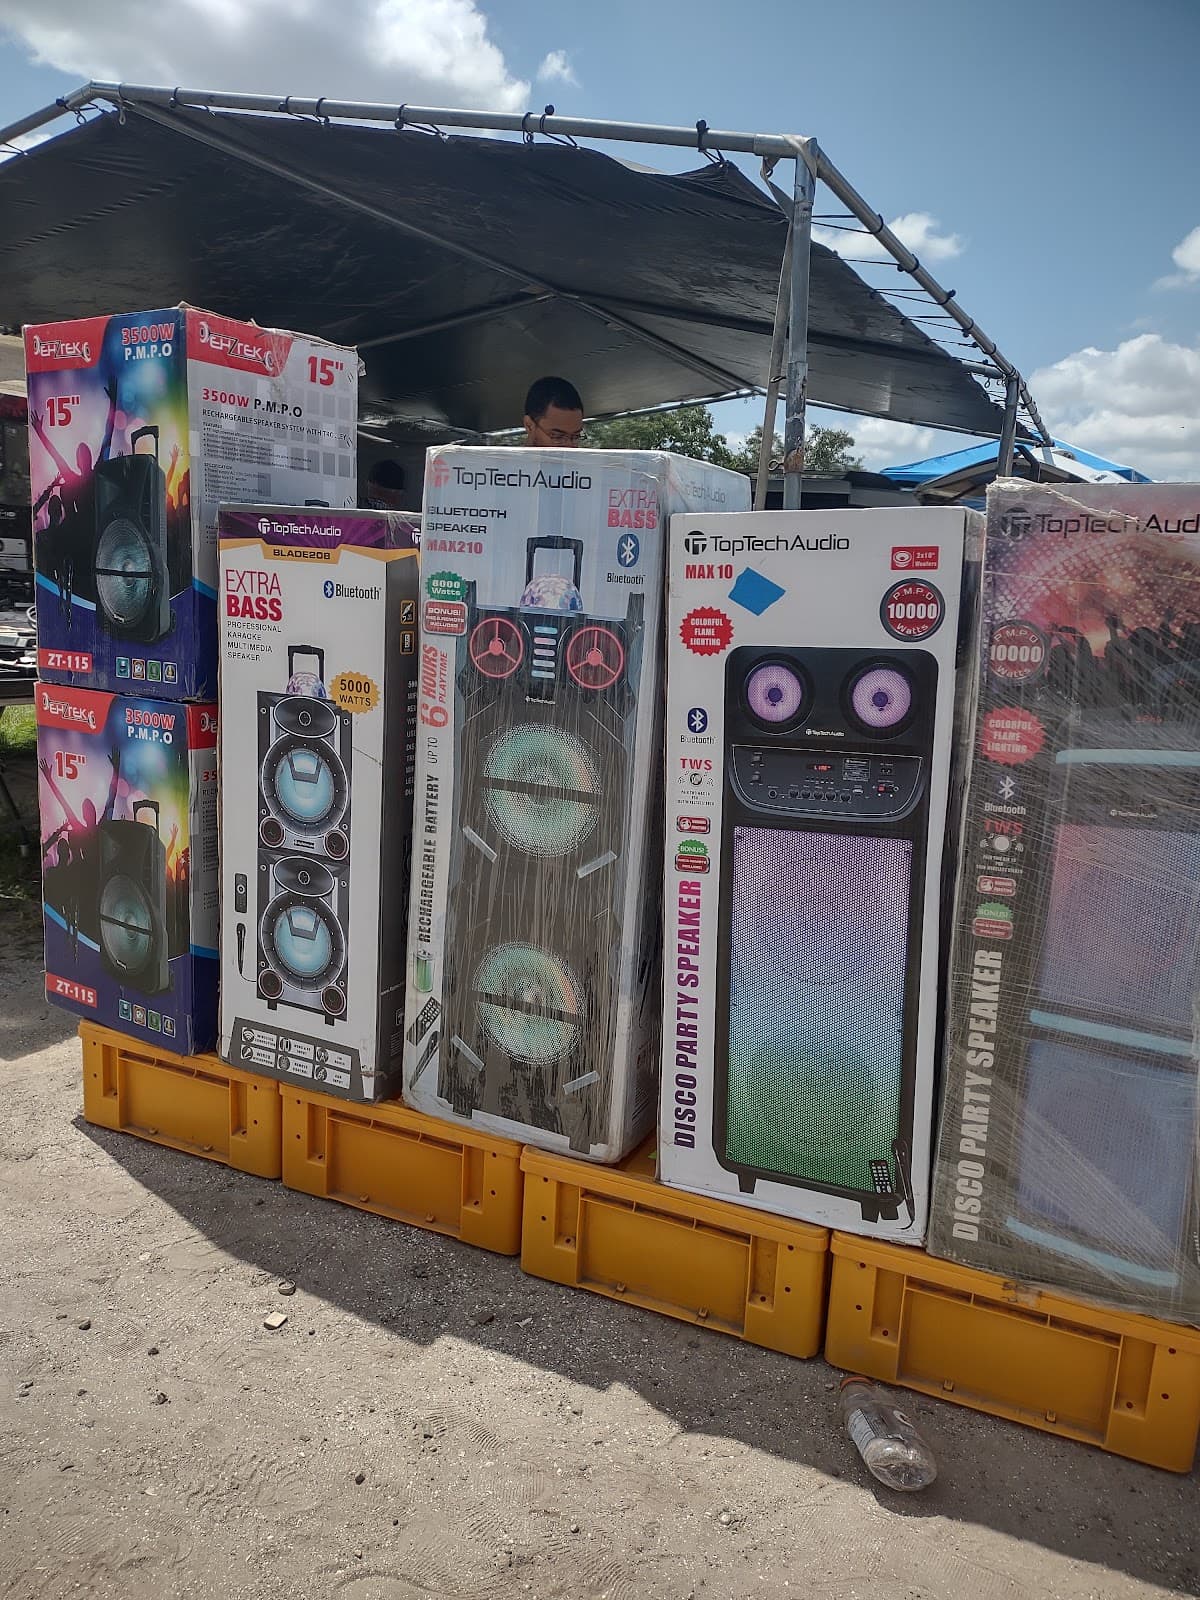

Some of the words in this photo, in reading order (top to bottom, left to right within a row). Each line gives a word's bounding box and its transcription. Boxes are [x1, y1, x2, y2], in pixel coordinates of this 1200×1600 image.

[122, 322, 174, 345] 3500W
[124, 344, 172, 360] P.M.P.O
[308, 354, 344, 386] 15"
[46, 394, 80, 426] 15"
[202, 388, 250, 408] 3500W
[254, 398, 303, 418] P.M.P.O
[254, 418, 282, 429] SPEAKER
[452, 467, 592, 490] TopTechAudio
[608, 489, 659, 508] EXTRA
[428, 506, 506, 518] BLUETOOTH
[608, 509, 658, 529] BASS
[272, 522, 342, 537] TopTechAudio
[426, 522, 487, 534] SPEAKER
[426, 539, 484, 554] MAX210
[710, 534, 850, 556] TopTechAudio
[607, 572, 644, 584] Bluetooth
[686, 564, 714, 579] MAX
[718, 564, 733, 579] 10
[226, 569, 282, 596] EXTRA
[336, 584, 380, 600] Bluetooth
[432, 587, 460, 596] Watts
[226, 594, 282, 622] BASS
[888, 603, 938, 619] 10000
[227, 621, 282, 632] PROFESSIONAL
[690, 618, 724, 626] COLORFUL
[896, 622, 928, 634] Watts
[228, 632, 262, 641] KARAOKE
[694, 628, 715, 636] FLAME
[228, 642, 272, 652] MULTIMEDIA
[690, 638, 720, 646] LIGHTING
[228, 652, 260, 662] SPEAKER
[990, 644, 1042, 662] 10000
[48, 653, 89, 670] ZT-115
[422, 644, 438, 700] HOURS
[438, 651, 448, 704] PLAYTIME
[997, 665, 1031, 678] Watts
[340, 679, 370, 694] 5000
[339, 694, 371, 706] WATTS
[126, 708, 176, 731] 3500W
[988, 719, 1032, 730] COLORFUL
[128, 726, 172, 744] P.M.P.O
[428, 736, 438, 748] TO
[680, 735, 714, 744] Bluetooth
[993, 731, 1021, 742] FLAME
[988, 742, 1027, 753] LIGHTING
[426, 750, 438, 764] UP
[680, 758, 712, 770] TWS
[55, 751, 86, 780] 15"
[424, 774, 440, 834] BATTERY
[984, 802, 1026, 815] Bluetooth
[984, 820, 1023, 835] TWS
[418, 839, 437, 943] RECHARGEABLE
[677, 880, 702, 988] SPEAKER
[56, 980, 94, 1003] ZT-115
[966, 950, 1002, 1068] SPEAKER
[676, 992, 699, 1069] PARTY
[674, 1074, 697, 1149] DISCO
[960, 1071, 993, 1158] PARTY
[952, 1161, 985, 1242] DISCO
